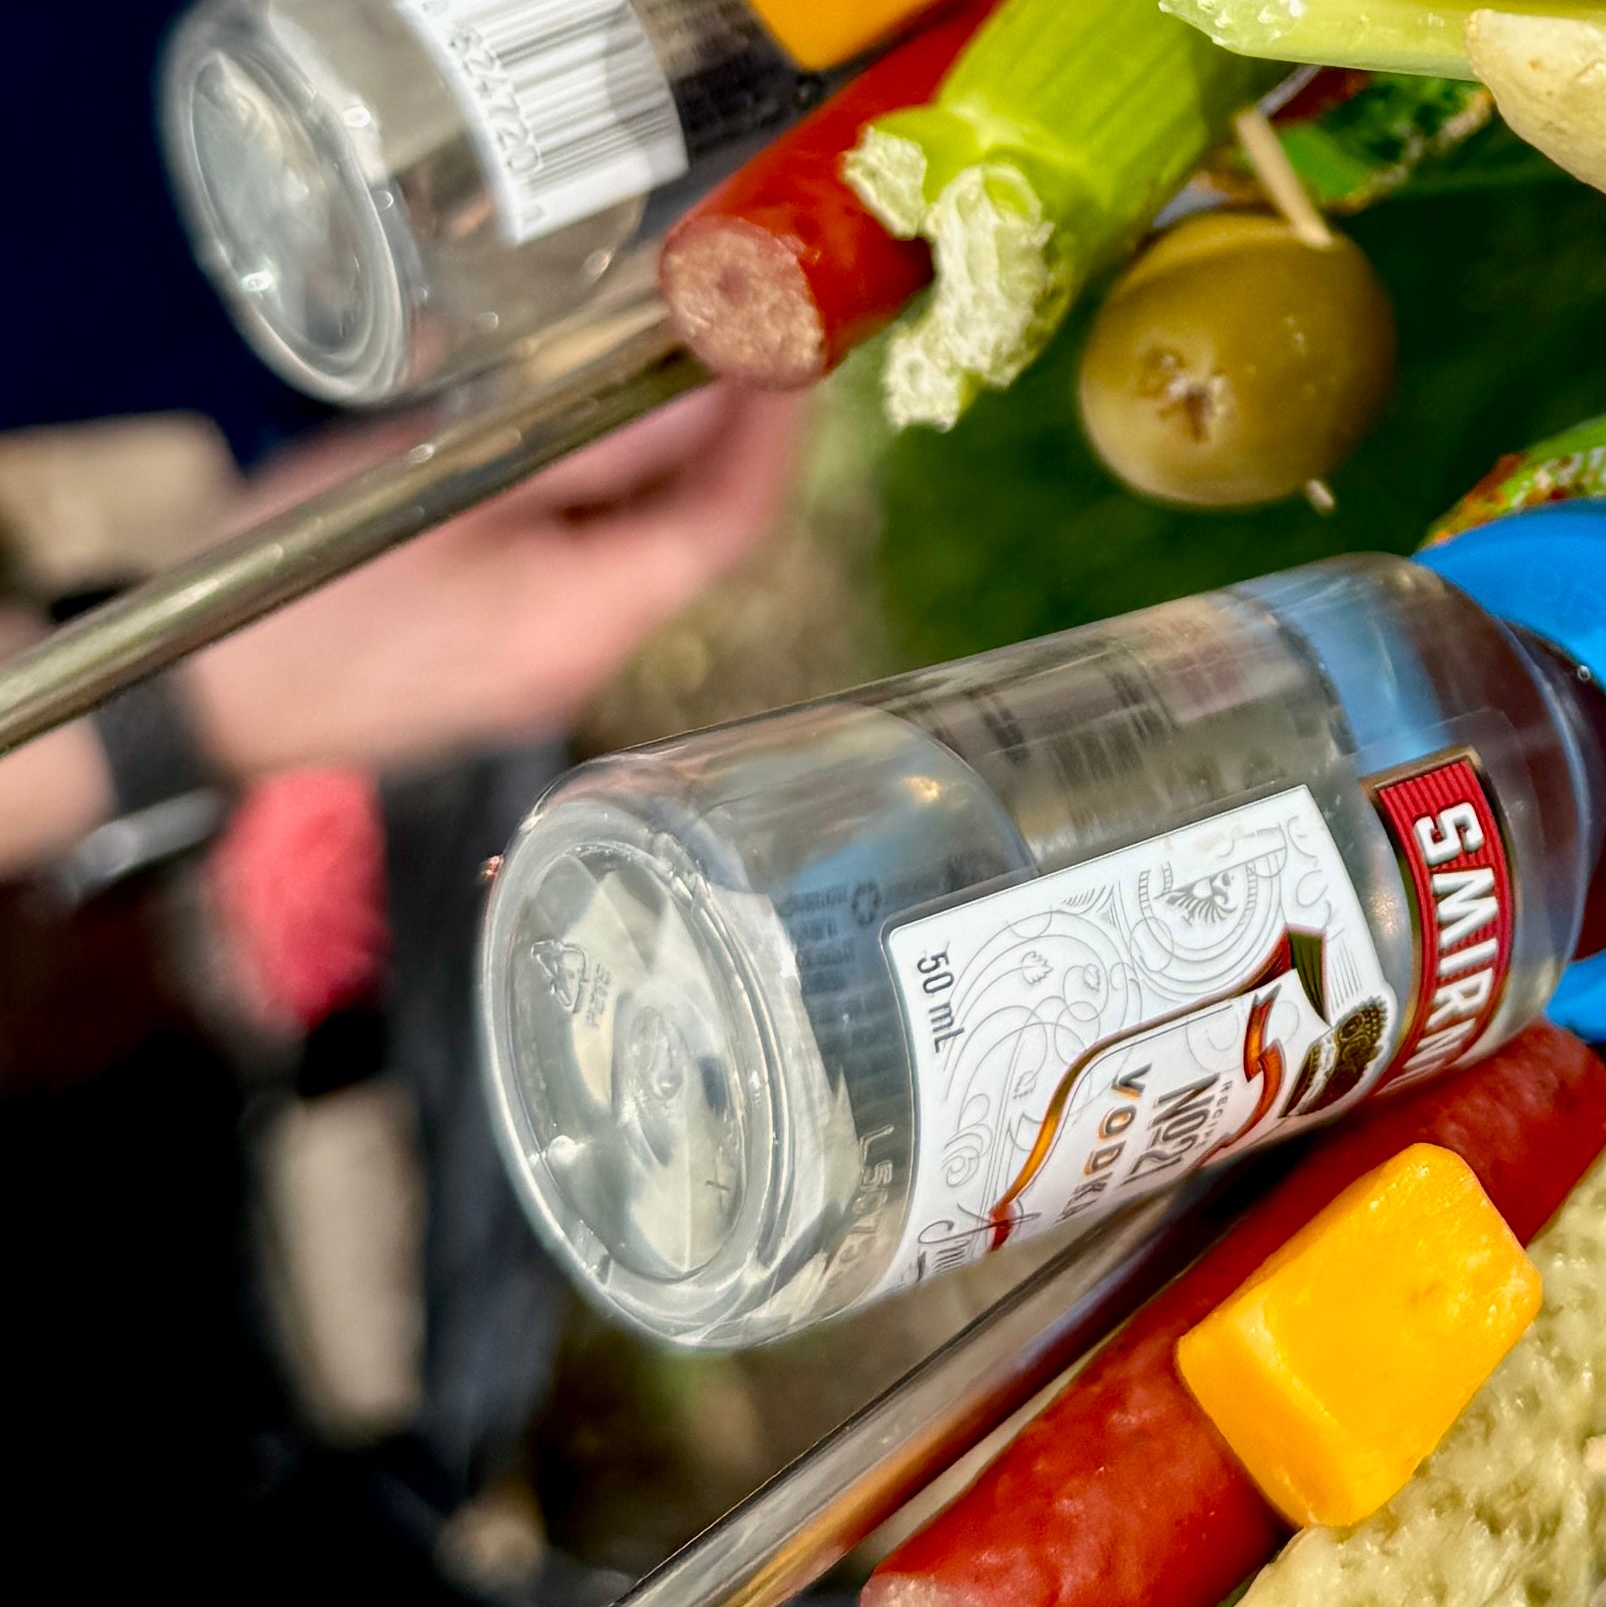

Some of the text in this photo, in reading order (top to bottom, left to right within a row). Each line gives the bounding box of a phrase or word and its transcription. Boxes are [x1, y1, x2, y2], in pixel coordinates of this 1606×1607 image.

[915, 949, 966, 1055] 50 mL
[1055, 1062, 1153, 1227] VODKA
